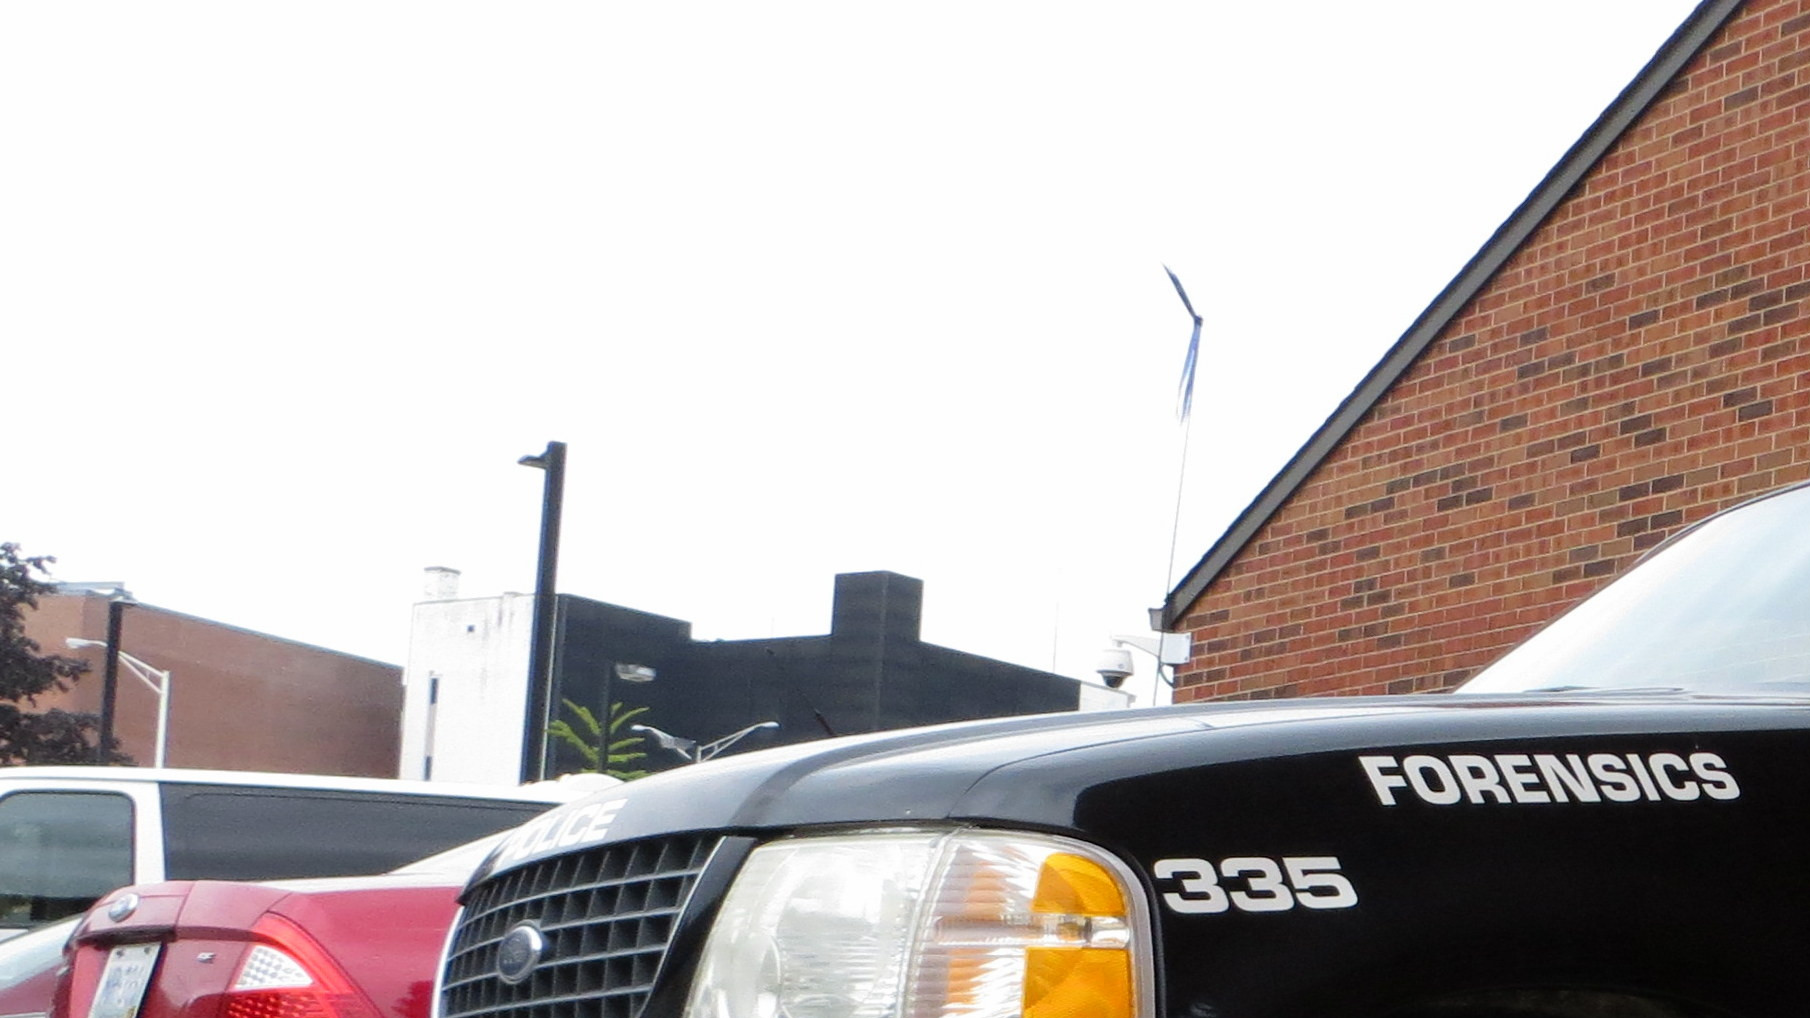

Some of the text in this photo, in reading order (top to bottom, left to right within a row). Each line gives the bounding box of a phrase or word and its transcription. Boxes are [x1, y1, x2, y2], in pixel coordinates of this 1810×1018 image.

[1358, 752, 1741, 806] FORENSICS
[494, 798, 628, 869] POLICE
[1154, 856, 1359, 915] 335
